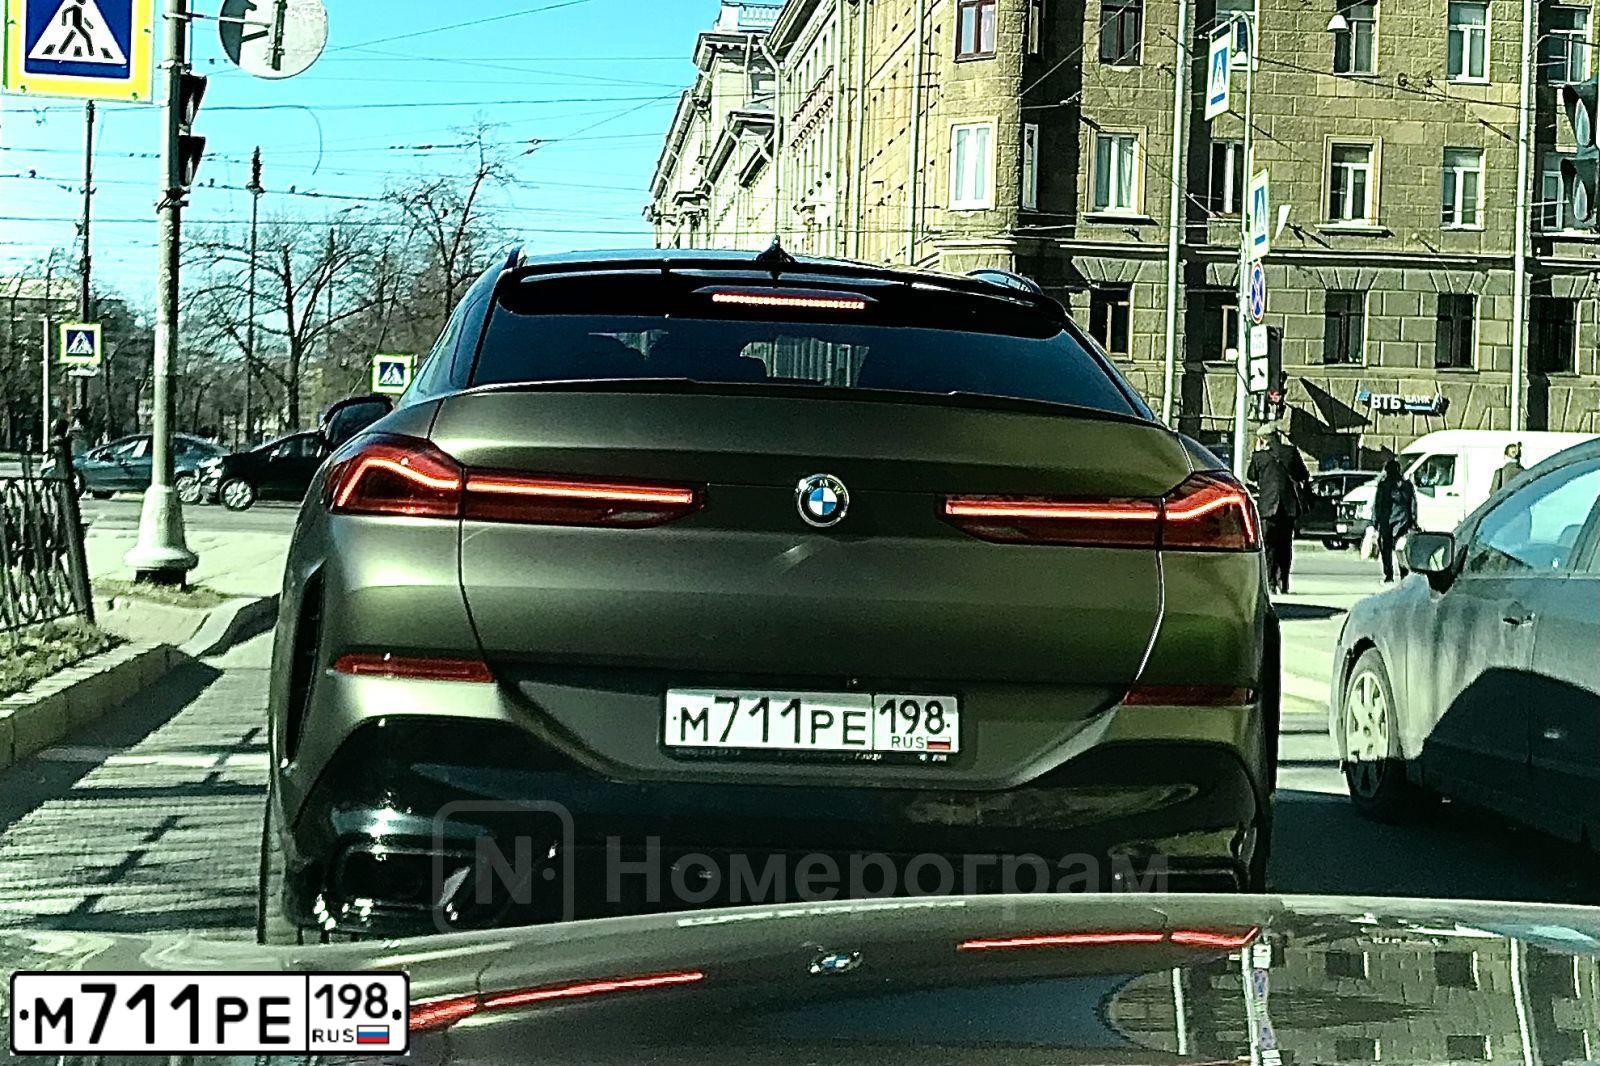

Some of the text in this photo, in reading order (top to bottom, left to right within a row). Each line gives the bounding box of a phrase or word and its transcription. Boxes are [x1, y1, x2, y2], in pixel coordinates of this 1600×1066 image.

[1371, 394, 1401, 410] ВТБ
[879, 698, 946, 735] 198
[891, 735, 925, 750] RUS
